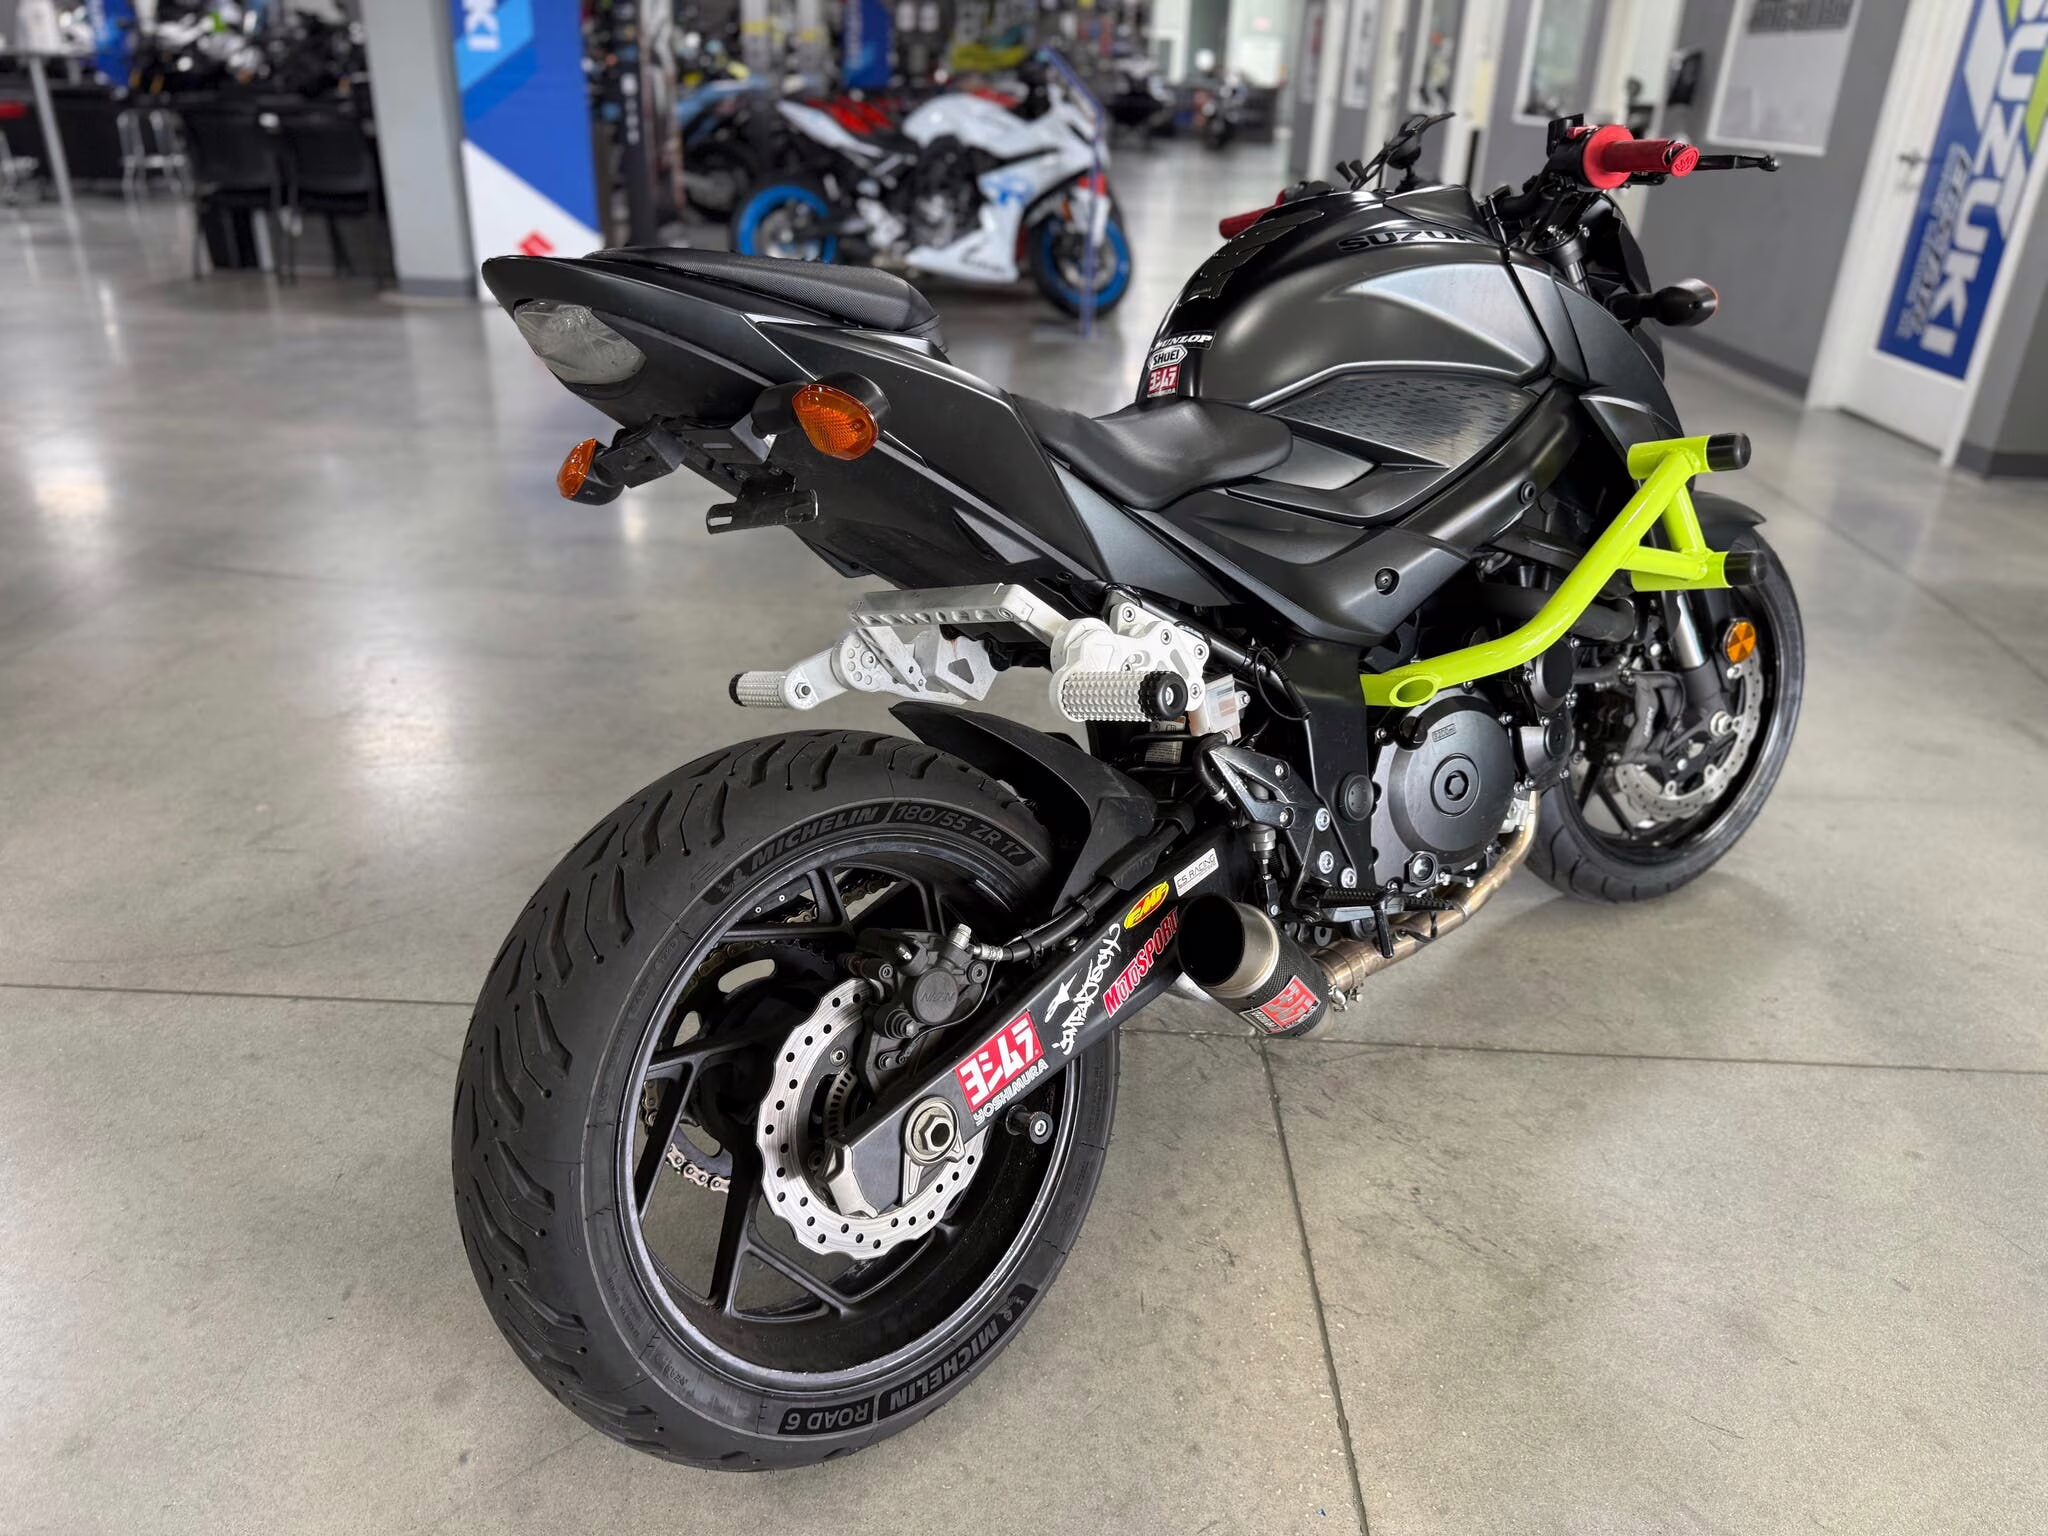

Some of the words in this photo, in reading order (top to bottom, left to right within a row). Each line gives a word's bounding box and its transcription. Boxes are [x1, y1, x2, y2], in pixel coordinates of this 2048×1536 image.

[1154, 335, 1213, 349] DUNLOP
[751, 806, 879, 872] MICHELIN
[895, 805, 972, 832] 180/55
[969, 823, 1002, 846] ZR
[999, 840, 1027, 858] 17
[959, 1017, 1034, 1107] ヨシムラ
[972, 1058, 1049, 1127] YOSHIMURA
[889, 1319, 1000, 1411] MICHELIN
[784, 1412, 801, 1431] 6
[806, 1402, 870, 1430] ROAD
